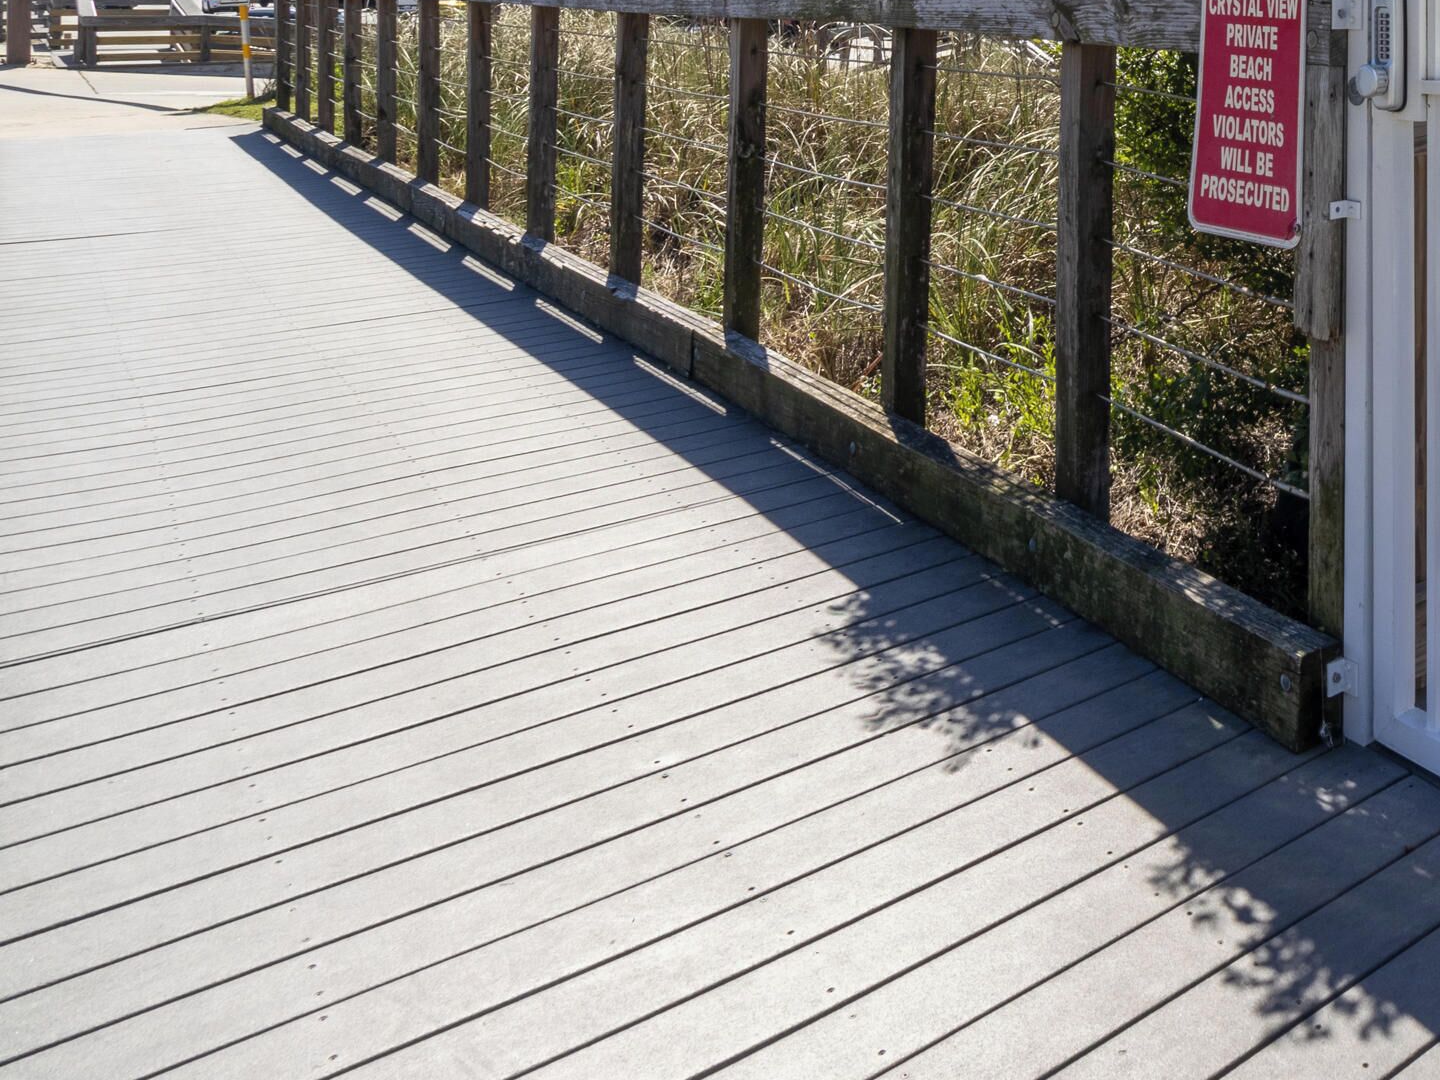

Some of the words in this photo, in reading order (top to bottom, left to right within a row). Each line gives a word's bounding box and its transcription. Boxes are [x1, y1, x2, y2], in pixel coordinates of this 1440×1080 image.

[1225, 23, 1279, 50] PRIVATE
[1229, 54, 1273, 82] BEACH
[1224, 85, 1275, 114] ACCESS
[1212, 114, 1285, 148] VIOLATORS
[1220, 146, 1253, 174] WILL
[1255, 151, 1274, 177] BE
[1200, 173, 1290, 213] PROSECUTED
